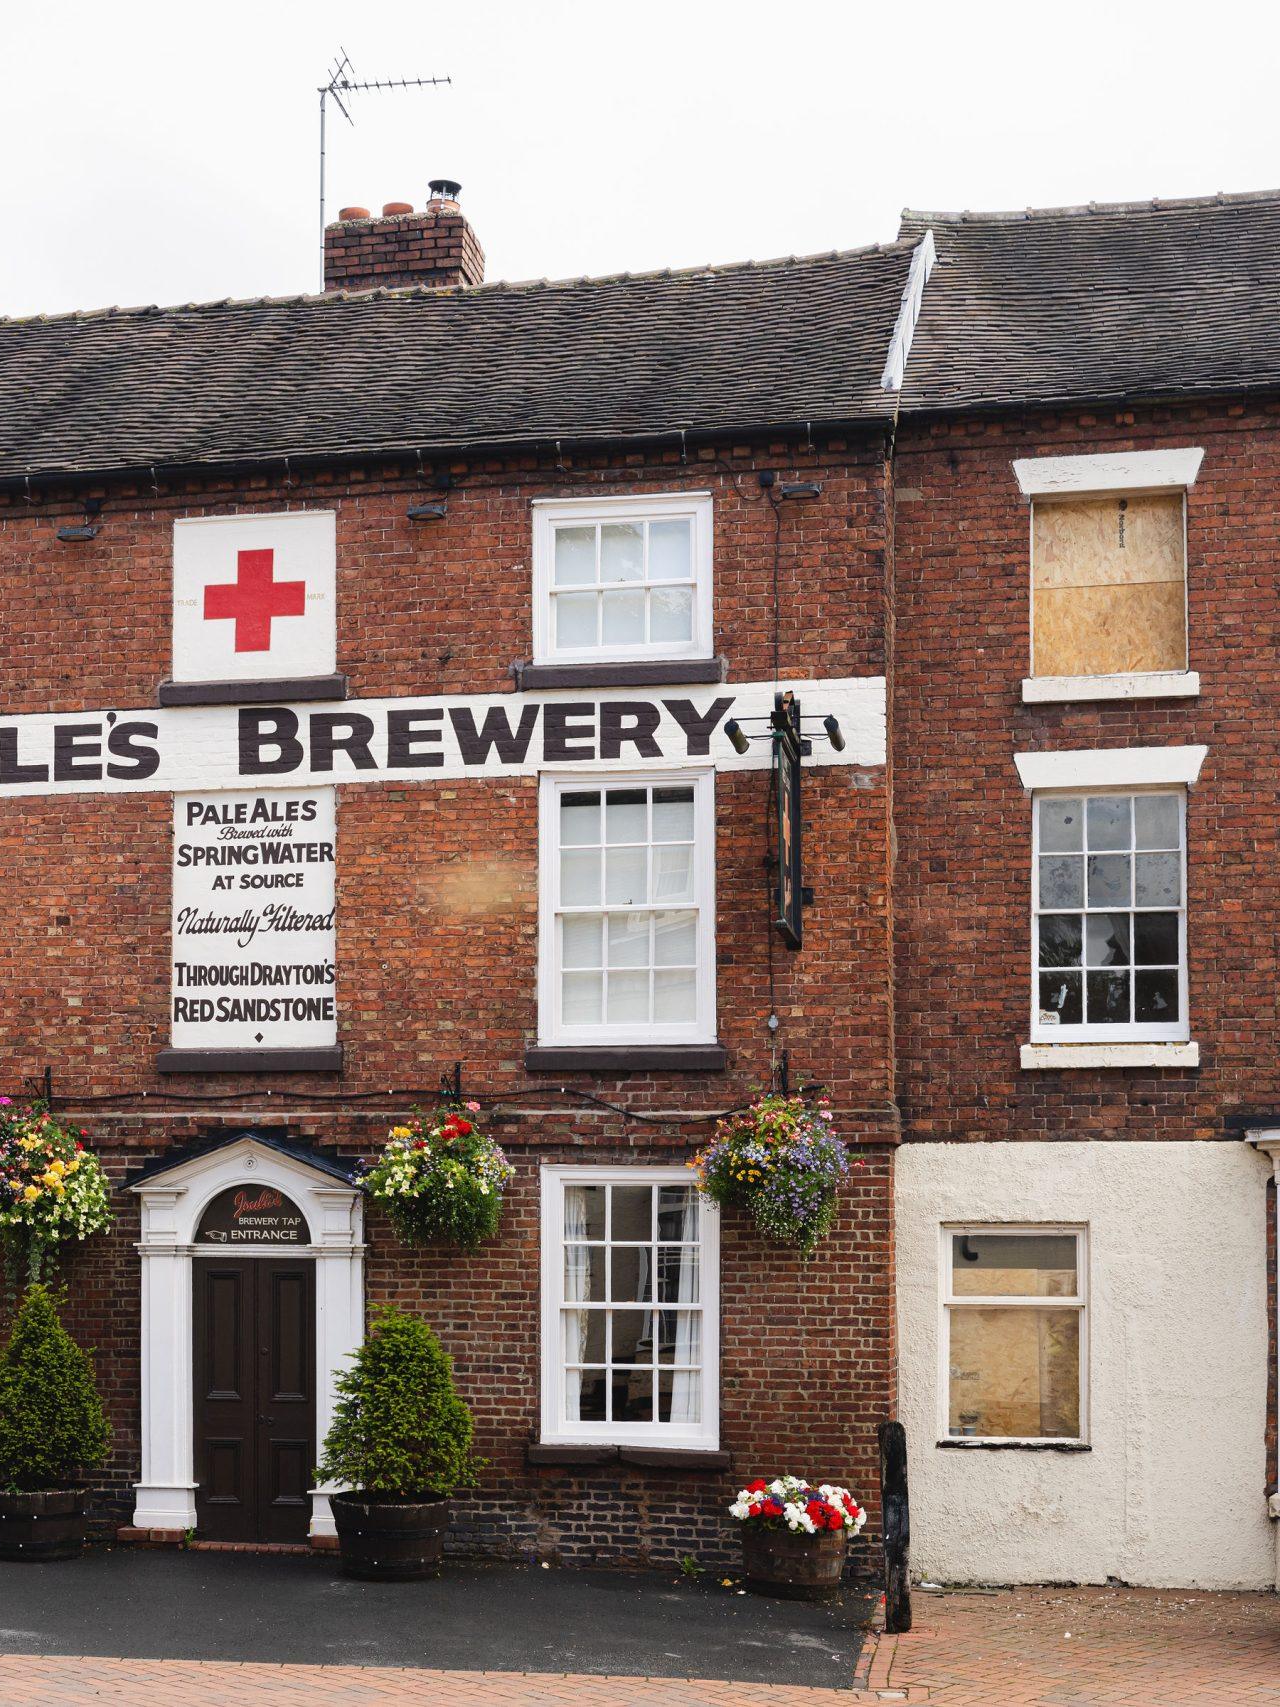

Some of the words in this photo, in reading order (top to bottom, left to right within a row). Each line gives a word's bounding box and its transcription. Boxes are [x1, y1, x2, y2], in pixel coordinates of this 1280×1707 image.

[177, 598, 198, 607] TRADE
[306, 592, 326, 601] MARK
[238, 696, 736, 776] BREWERY
[186, 801, 248, 826] PALE
[249, 798, 318, 824] ALES
[217, 826, 267, 841] Brewed
[265, 823, 293, 839] with
[177, 844, 259, 867] SPRING
[260, 841, 335, 865] WATER
[211, 875, 235, 890] AT
[239, 873, 304, 890] SOURCE
[177, 906, 261, 948] Naturally
[258, 903, 336, 932] Filtered
[174, 962, 249, 986] THROUGH
[250, 958, 335, 986] DRAYTON'S
[174, 997, 215, 1022] RED
[215, 997, 334, 1022] SANDSTONE
[238, 1217, 279, 1226] BREWERY
[282, 1217, 302, 1226] TAP
[230, 1230, 298, 1240] ENTRANCE
